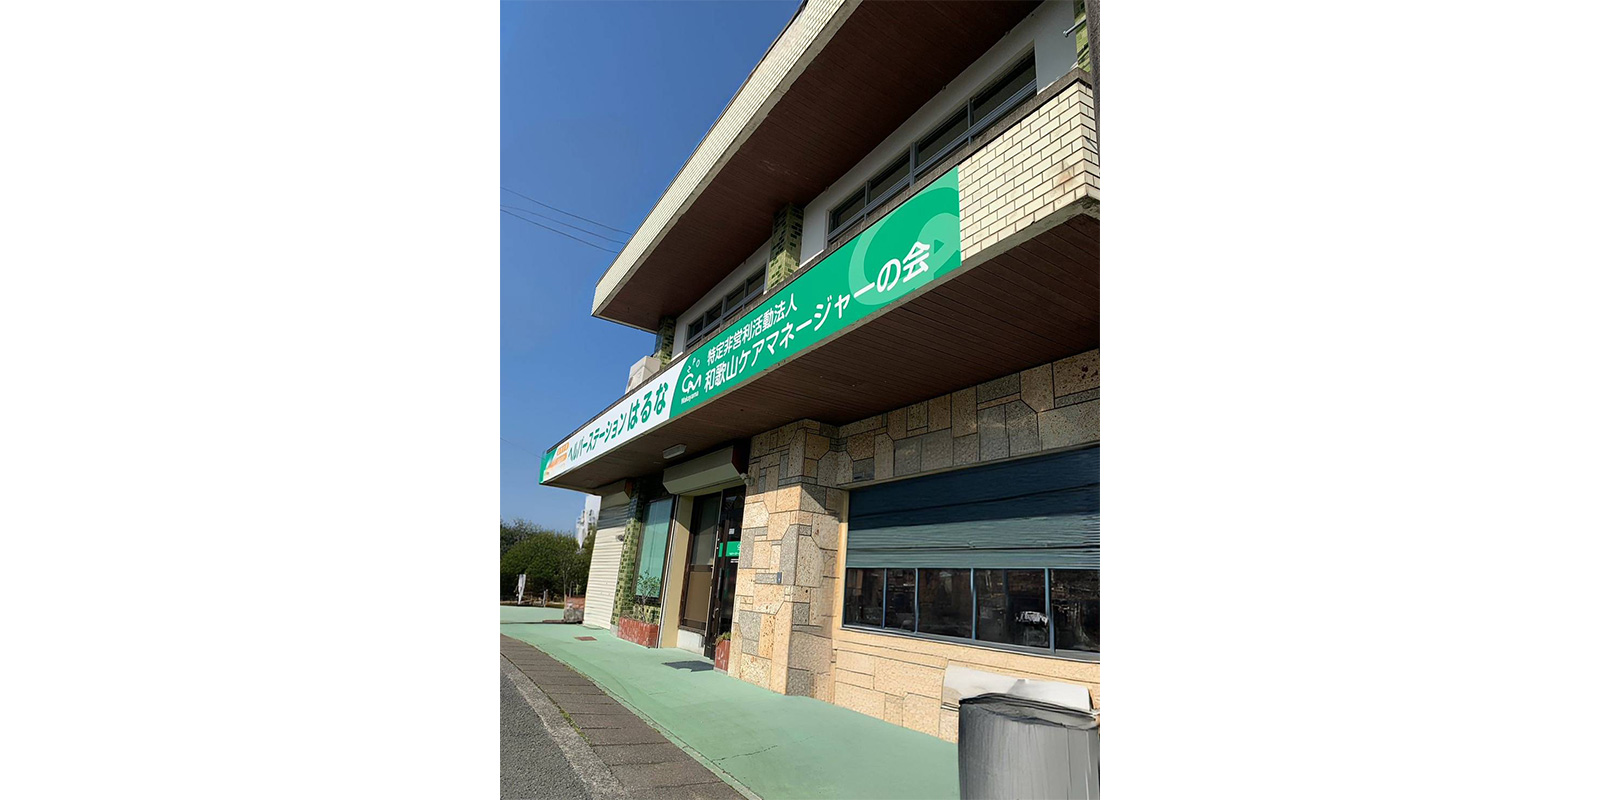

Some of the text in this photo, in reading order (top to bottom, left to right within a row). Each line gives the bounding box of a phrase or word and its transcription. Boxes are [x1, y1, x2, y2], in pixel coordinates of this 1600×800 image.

[704, 241, 931, 393] 和歌山ケアマネージャーの会
[707, 293, 798, 366] 特定非営利活動法人
